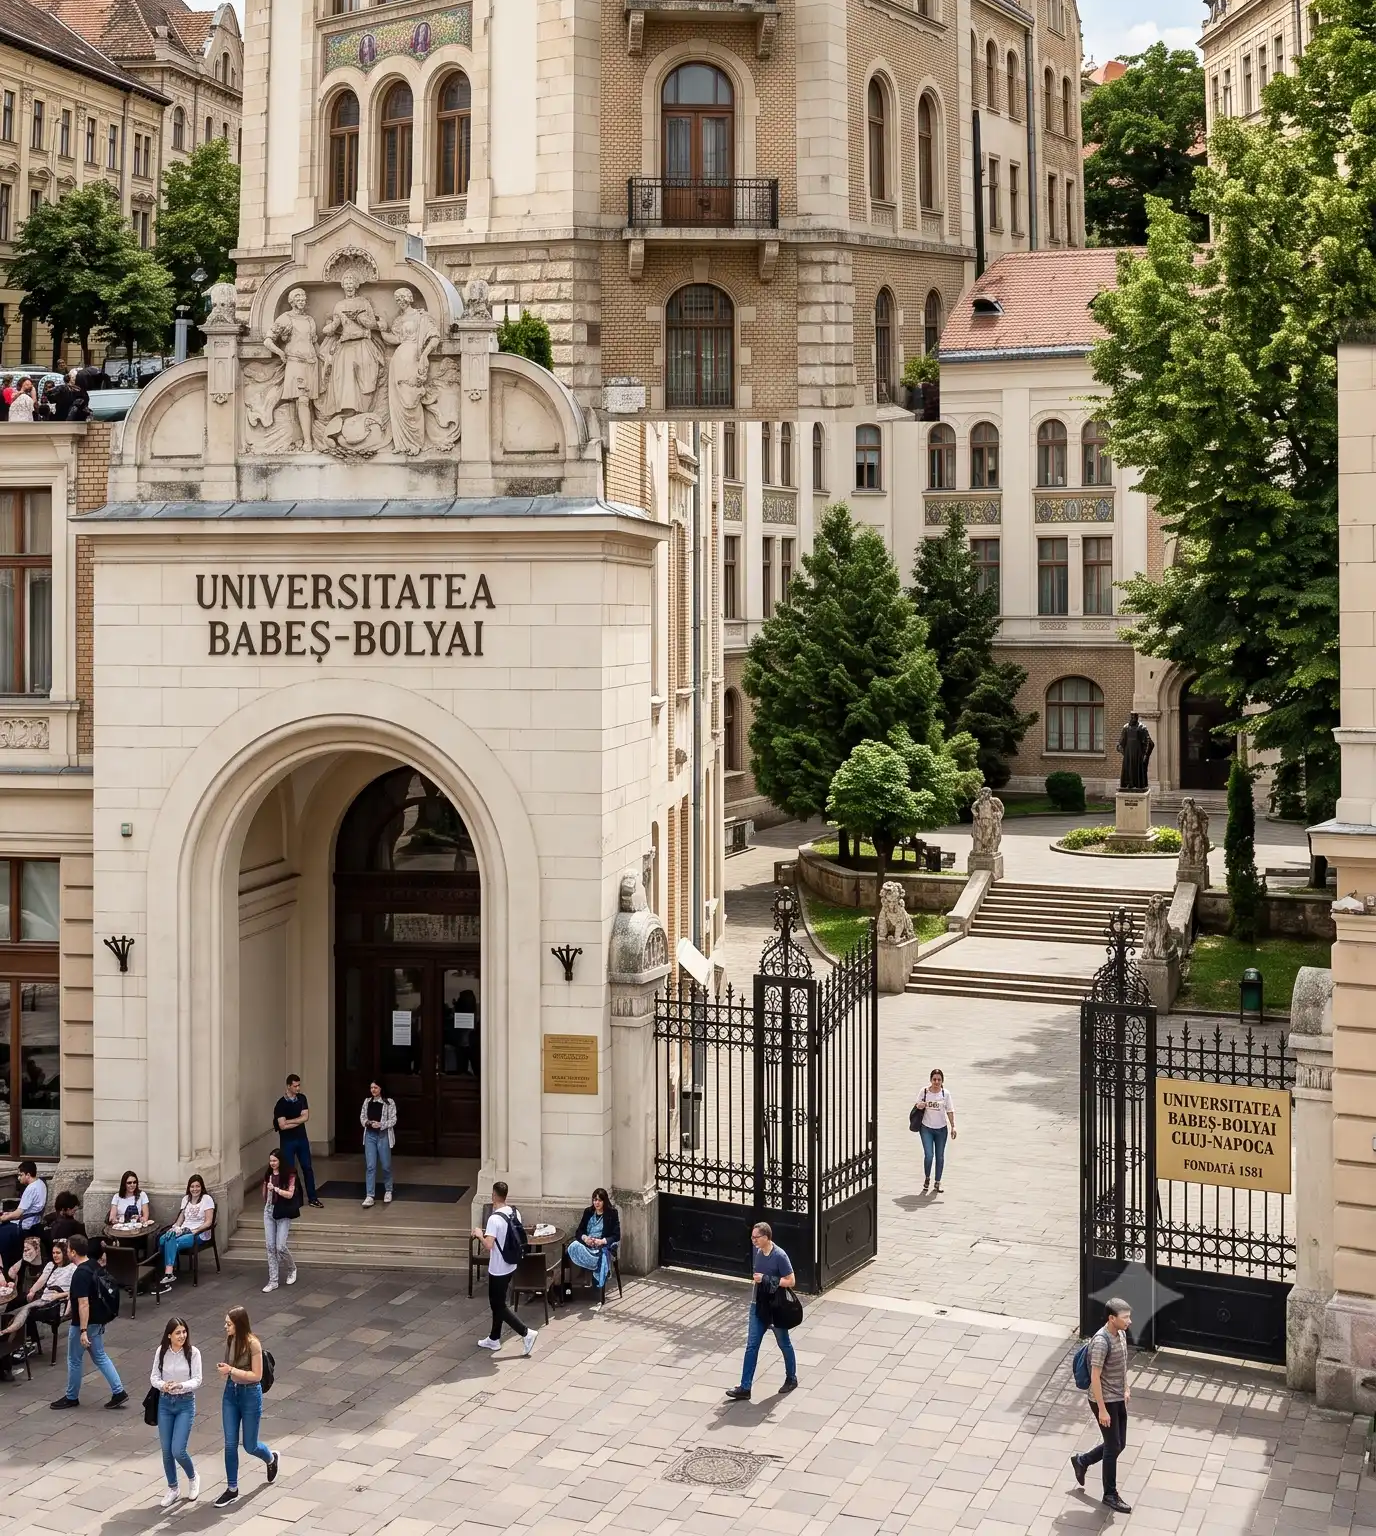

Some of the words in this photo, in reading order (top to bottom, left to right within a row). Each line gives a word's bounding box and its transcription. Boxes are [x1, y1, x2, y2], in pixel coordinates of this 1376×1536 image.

[195, 573, 497, 610] UNIVERSITATEA
[208, 620, 484, 663] BABEȘ-BOLYAI
[1163, 1092, 1282, 1118] UNIVERSITATEA
[1168, 1111, 1277, 1137] BABEȘ-BOLYAI
[1171, 1130, 1275, 1156] CLUJ-NAPOCA
[1183, 1158, 1236, 1176] FONDATĂ
